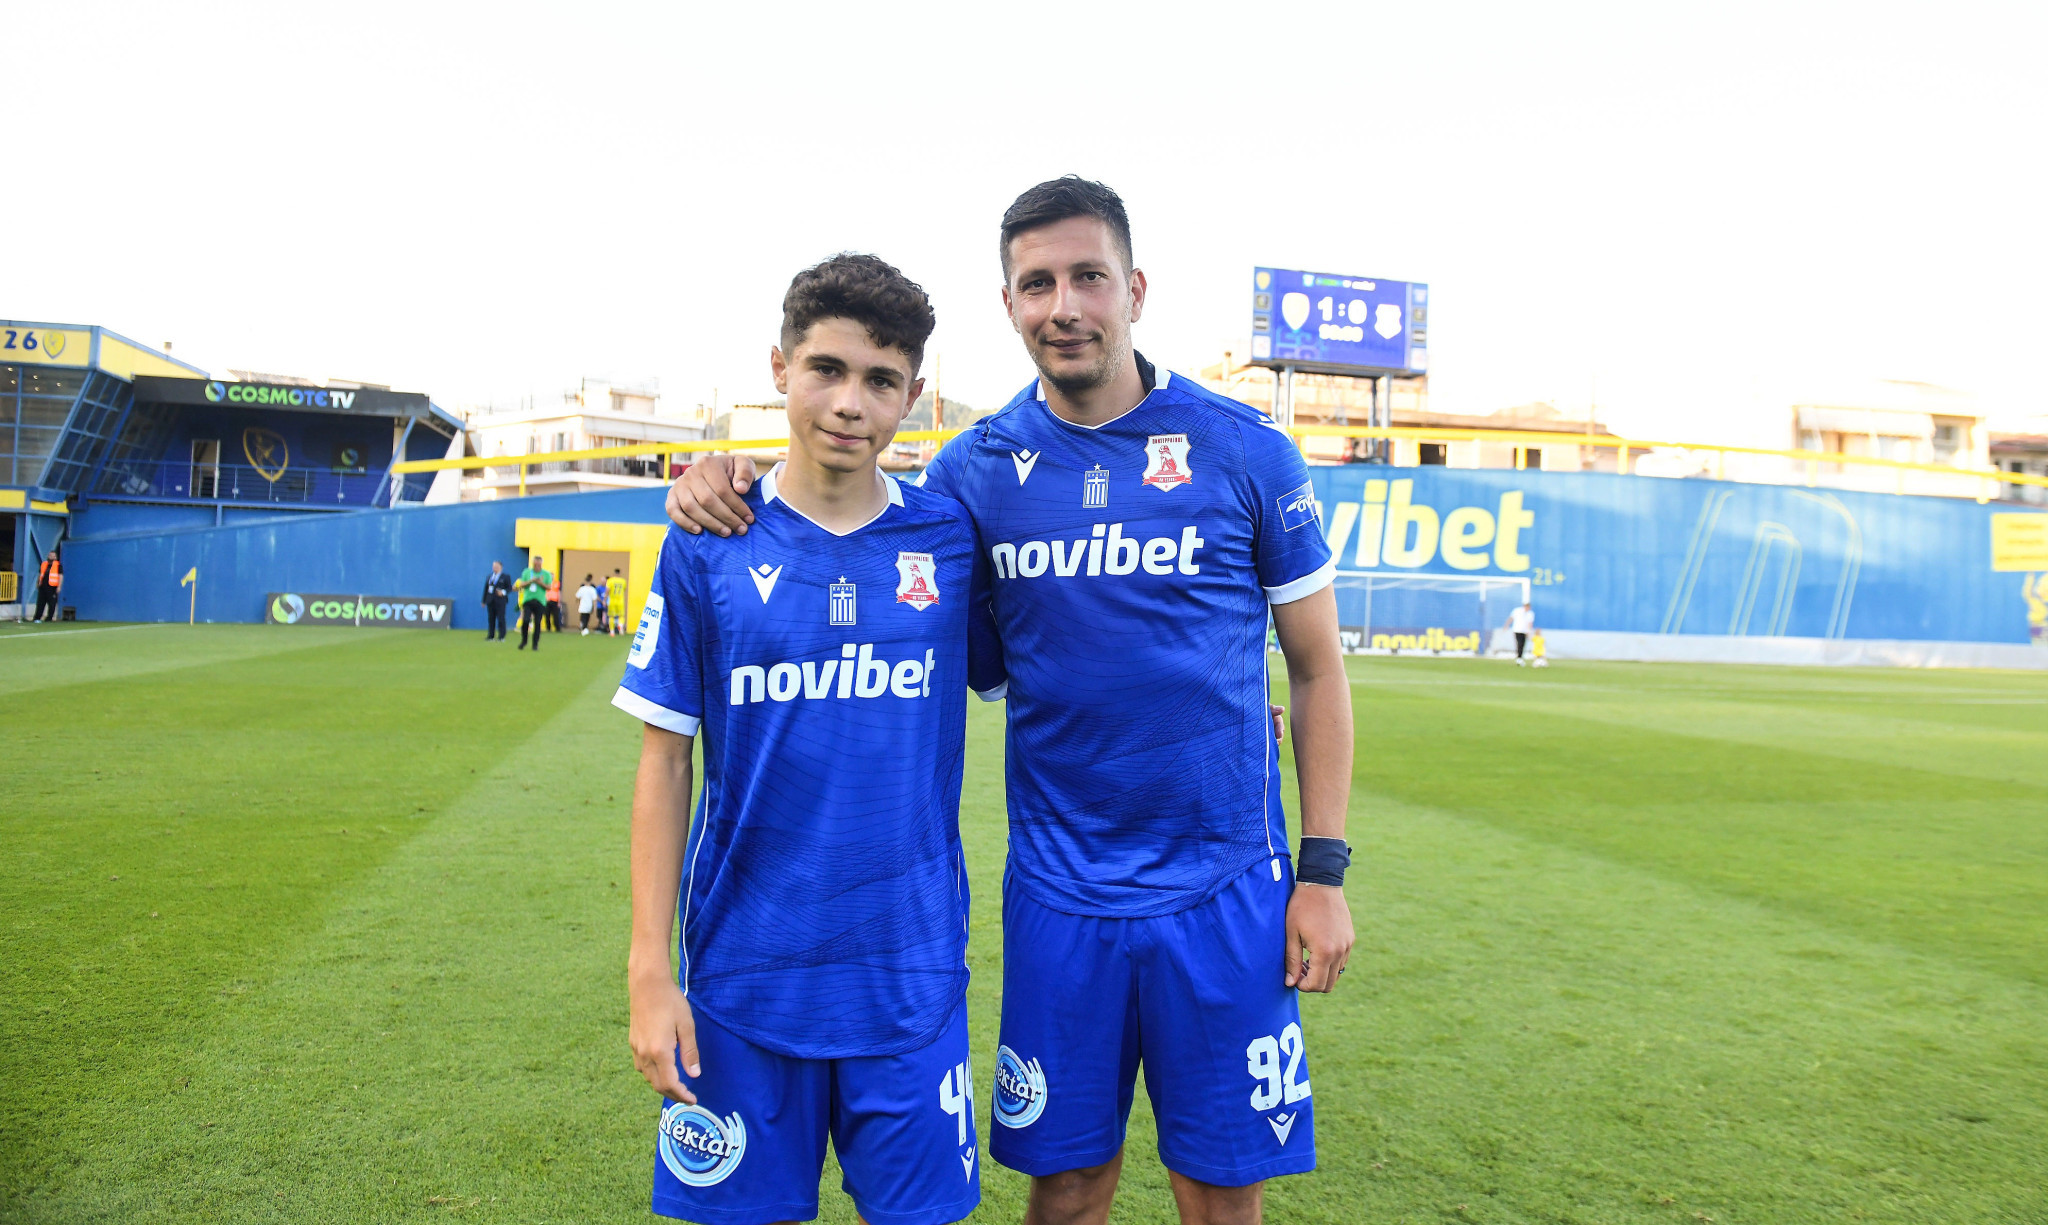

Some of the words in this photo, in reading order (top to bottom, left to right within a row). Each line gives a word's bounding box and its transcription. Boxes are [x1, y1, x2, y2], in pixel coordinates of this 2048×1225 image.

[228, 385, 328, 407] COSMOTE
[329, 391, 356, 409] TV
[992, 523, 1204, 579] novibet
[309, 600, 418, 622] COSMOTE
[419, 603, 447, 622] TV
[730, 643, 936, 706] novibet
[1246, 1021, 1313, 1112] 92
